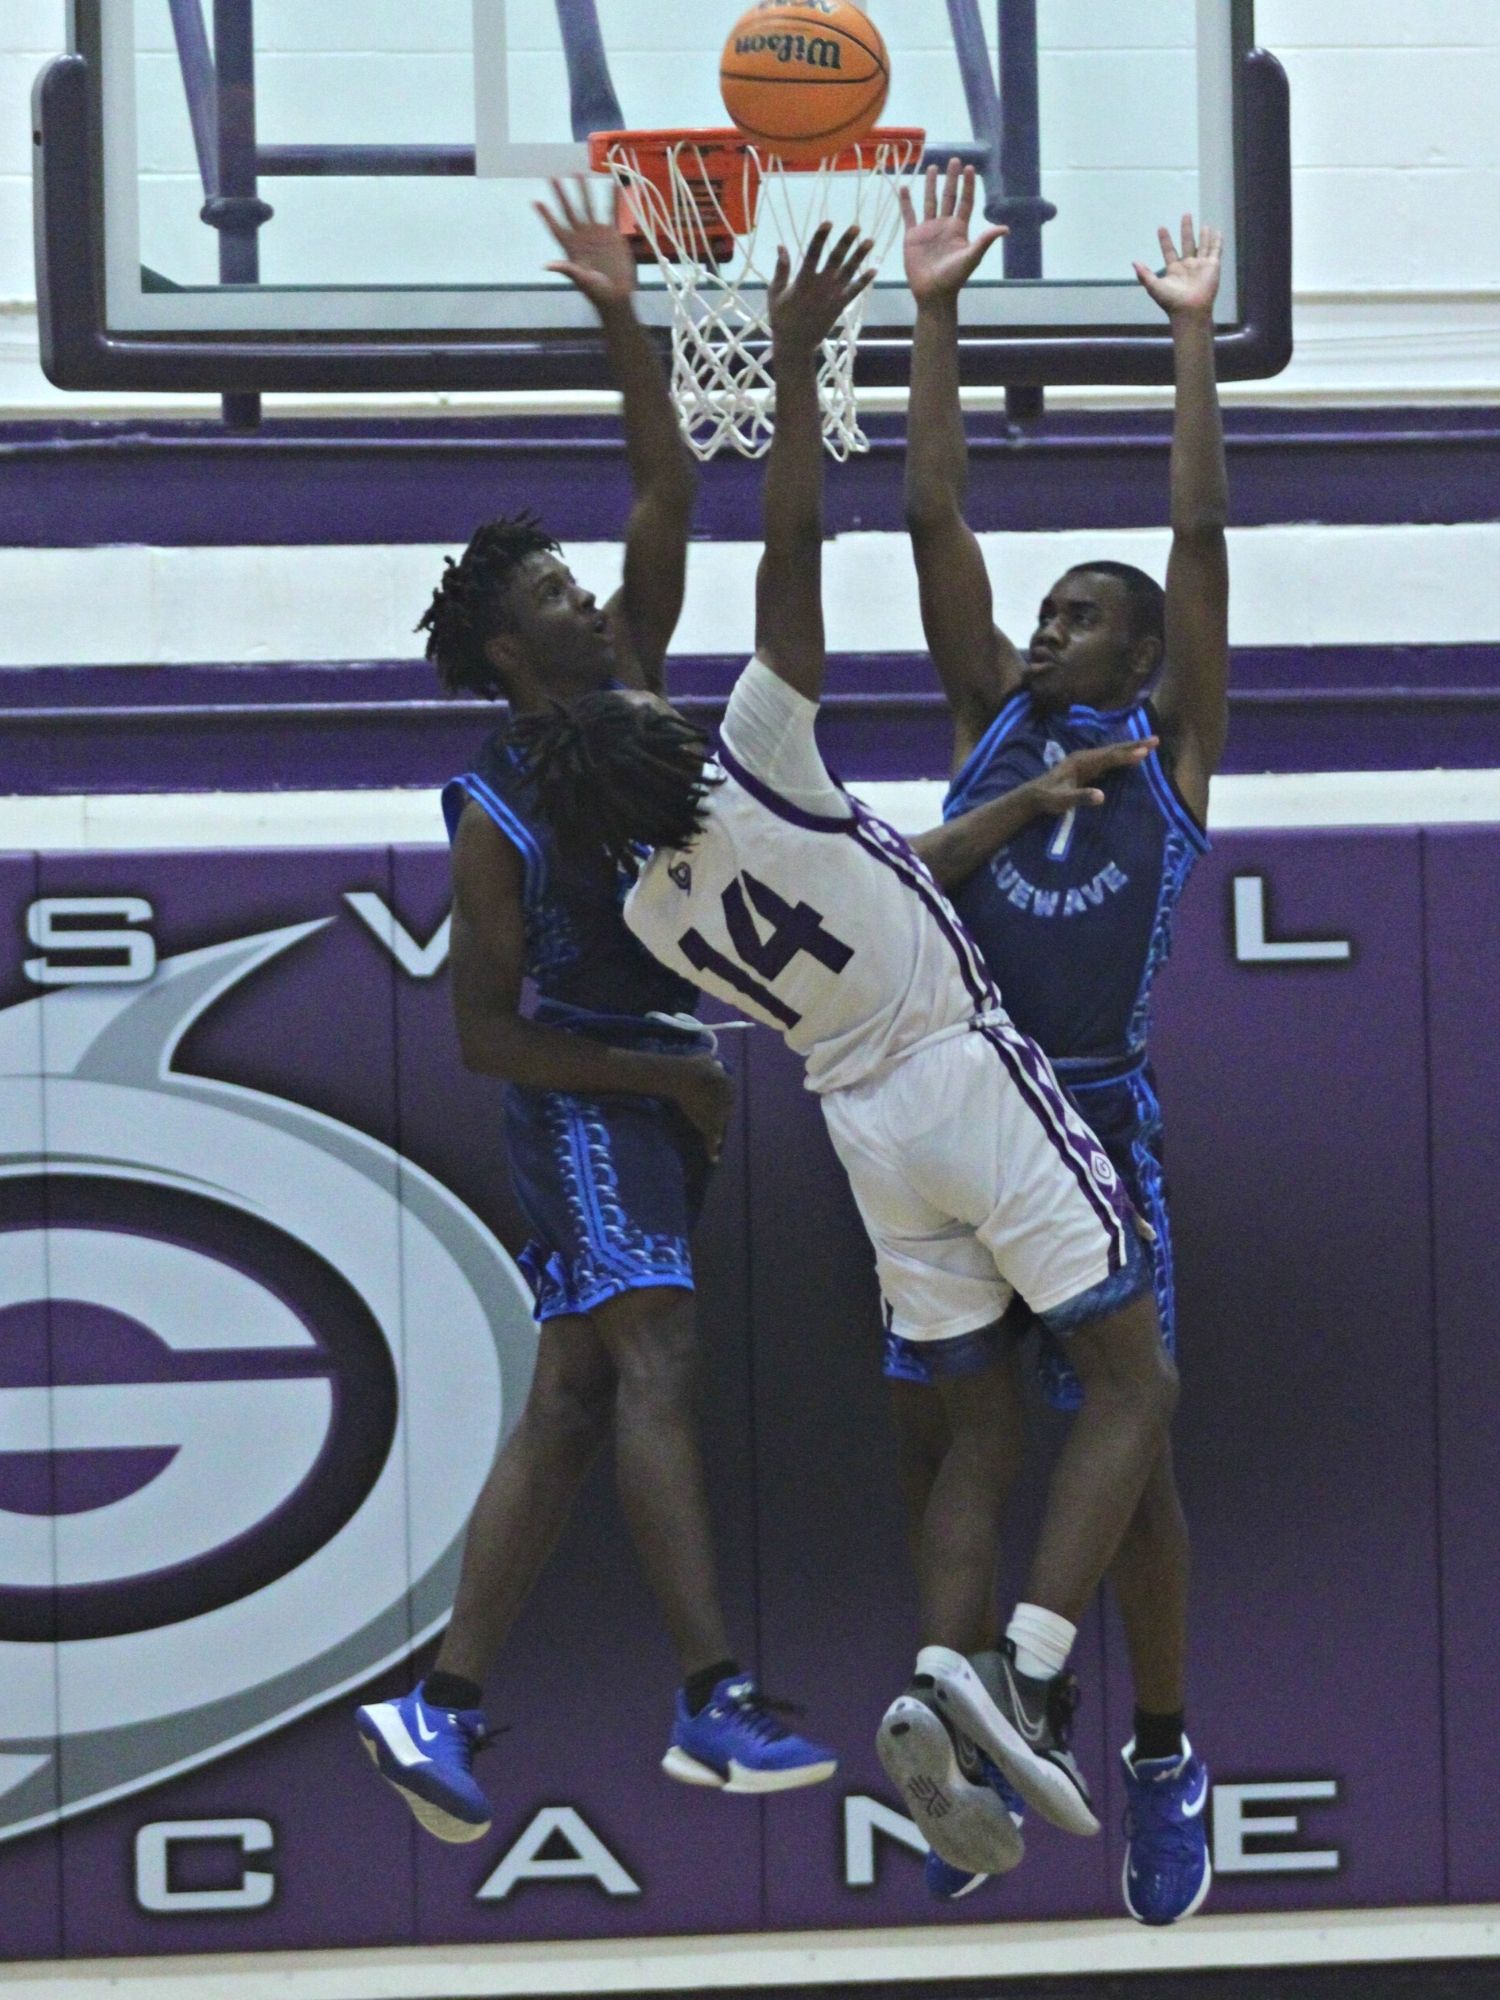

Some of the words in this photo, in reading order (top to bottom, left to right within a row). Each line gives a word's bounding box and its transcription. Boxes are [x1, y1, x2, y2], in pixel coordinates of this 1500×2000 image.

[734, 33, 842, 70] Wilson
[988, 846, 1130, 918] LUEWAVE
[677, 869, 855, 1030] 14
